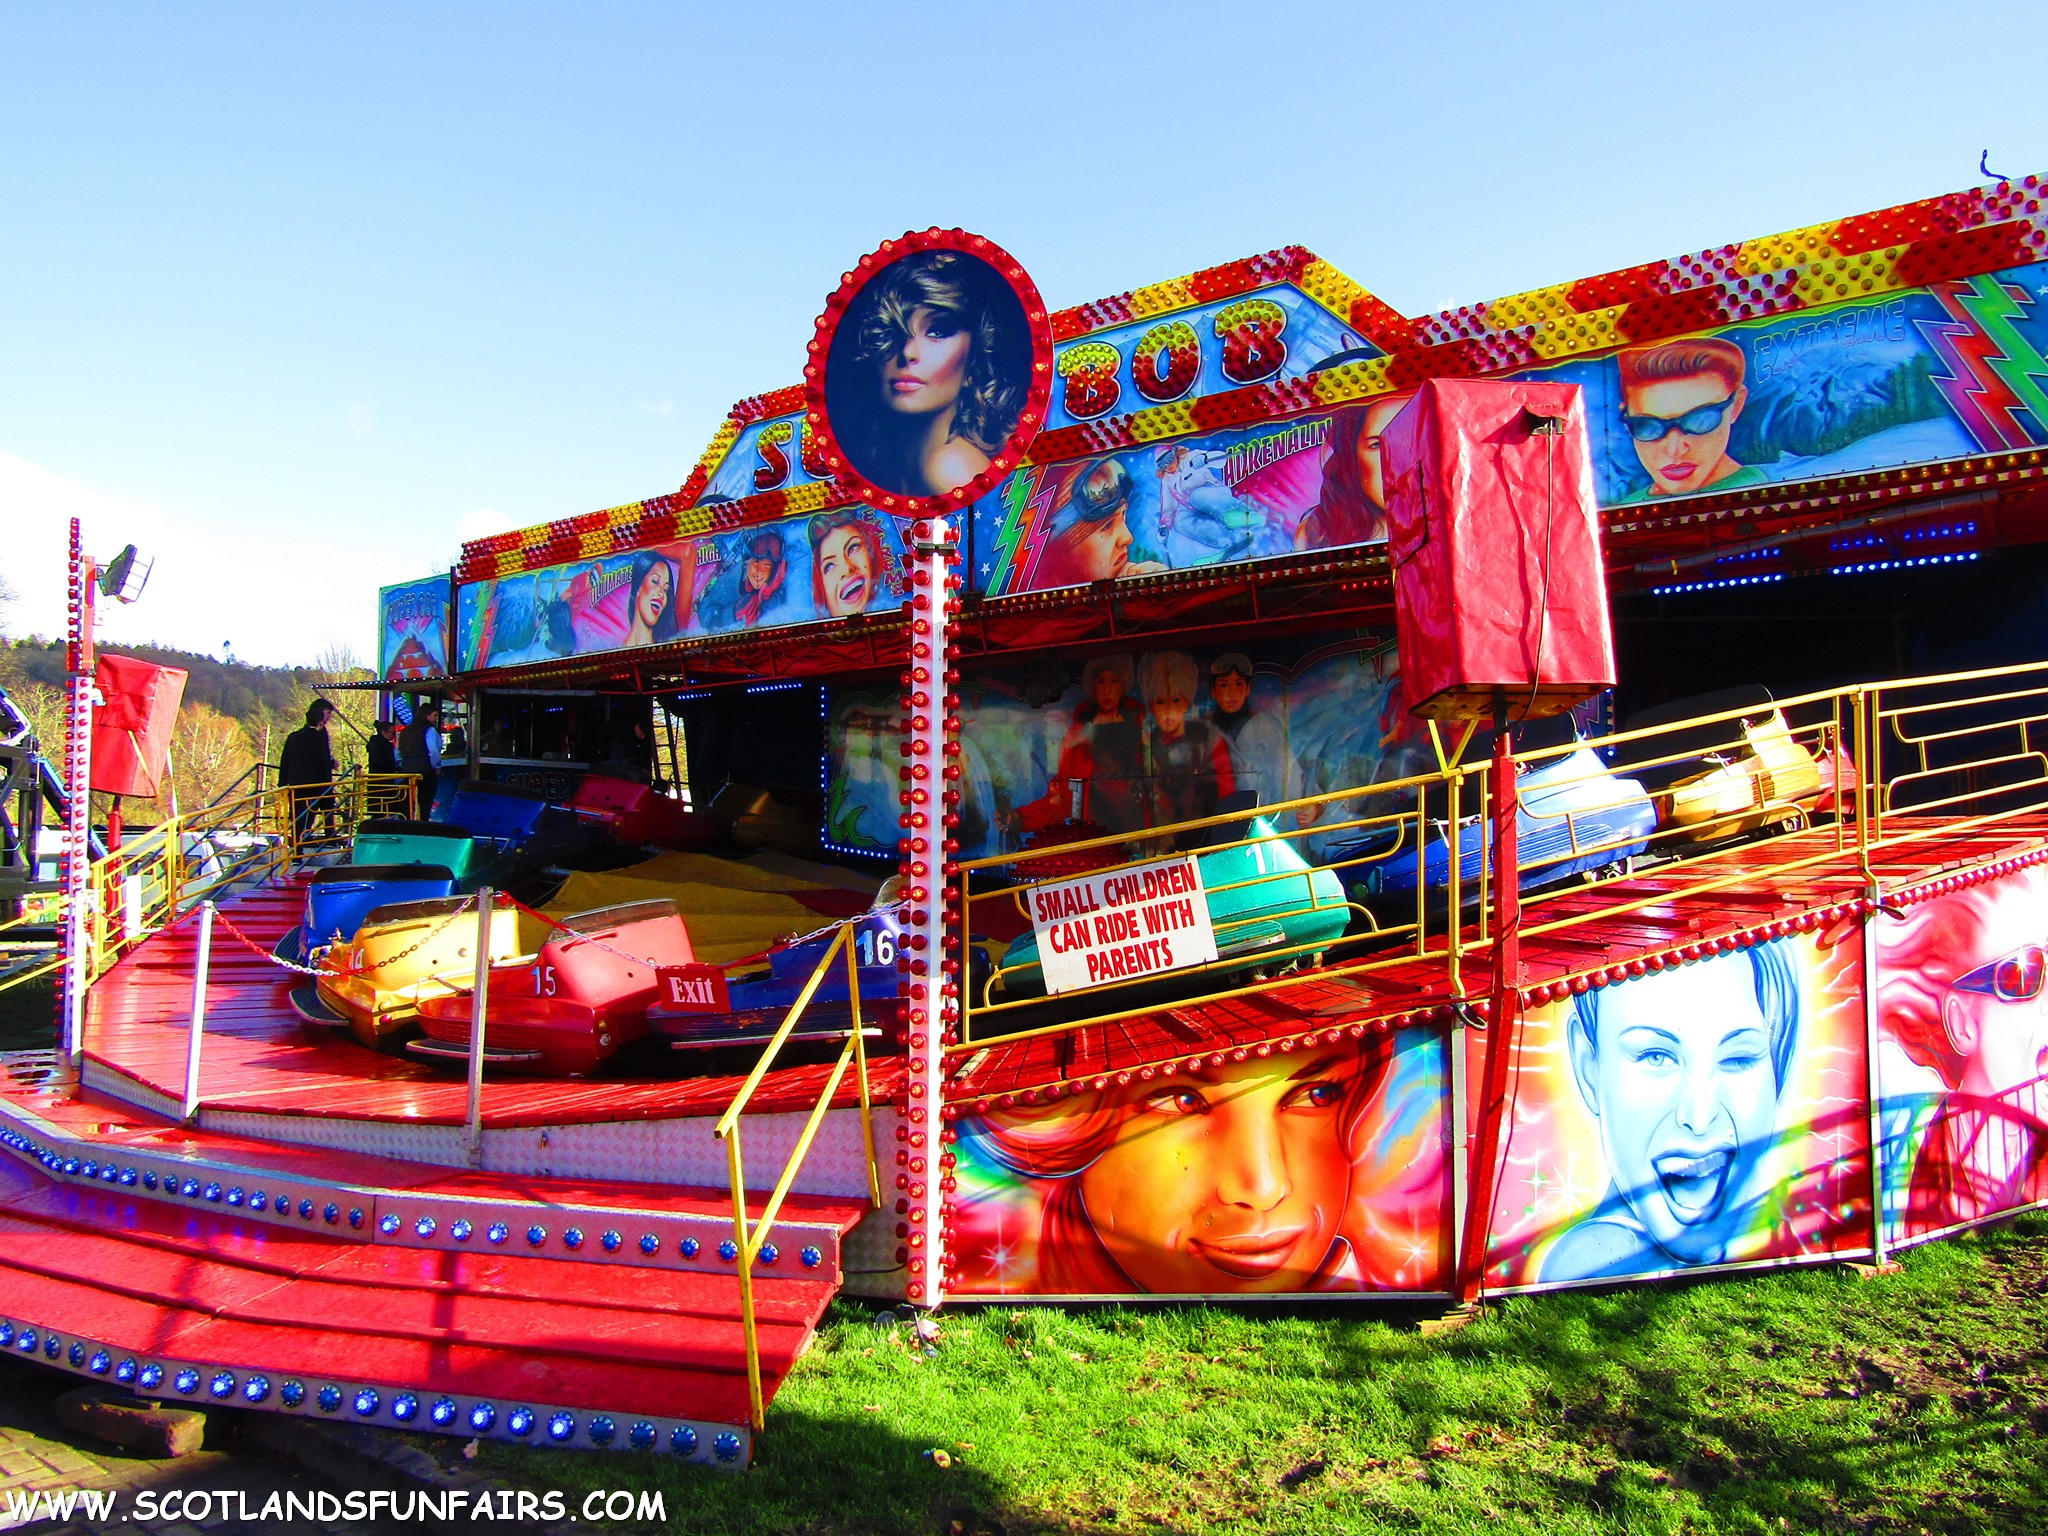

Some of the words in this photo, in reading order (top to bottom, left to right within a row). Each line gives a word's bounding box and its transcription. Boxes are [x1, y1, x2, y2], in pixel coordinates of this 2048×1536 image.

[1058, 299, 1288, 421] BOB
[1753, 299, 1906, 384] EXTREME
[1222, 417, 1333, 488] ADRENALIN
[1035, 883, 1100, 923] SMALL
[1103, 862, 1197, 908] CHILDREN
[856, 929, 894, 966] 16
[1050, 919, 1093, 954] CAN
[1093, 909, 1141, 945] RIDE
[1141, 898, 1195, 935] WITH
[531, 965, 556, 996] 15
[1086, 937, 1173, 983] PARENTS
[668, 976, 716, 1004] Exit
